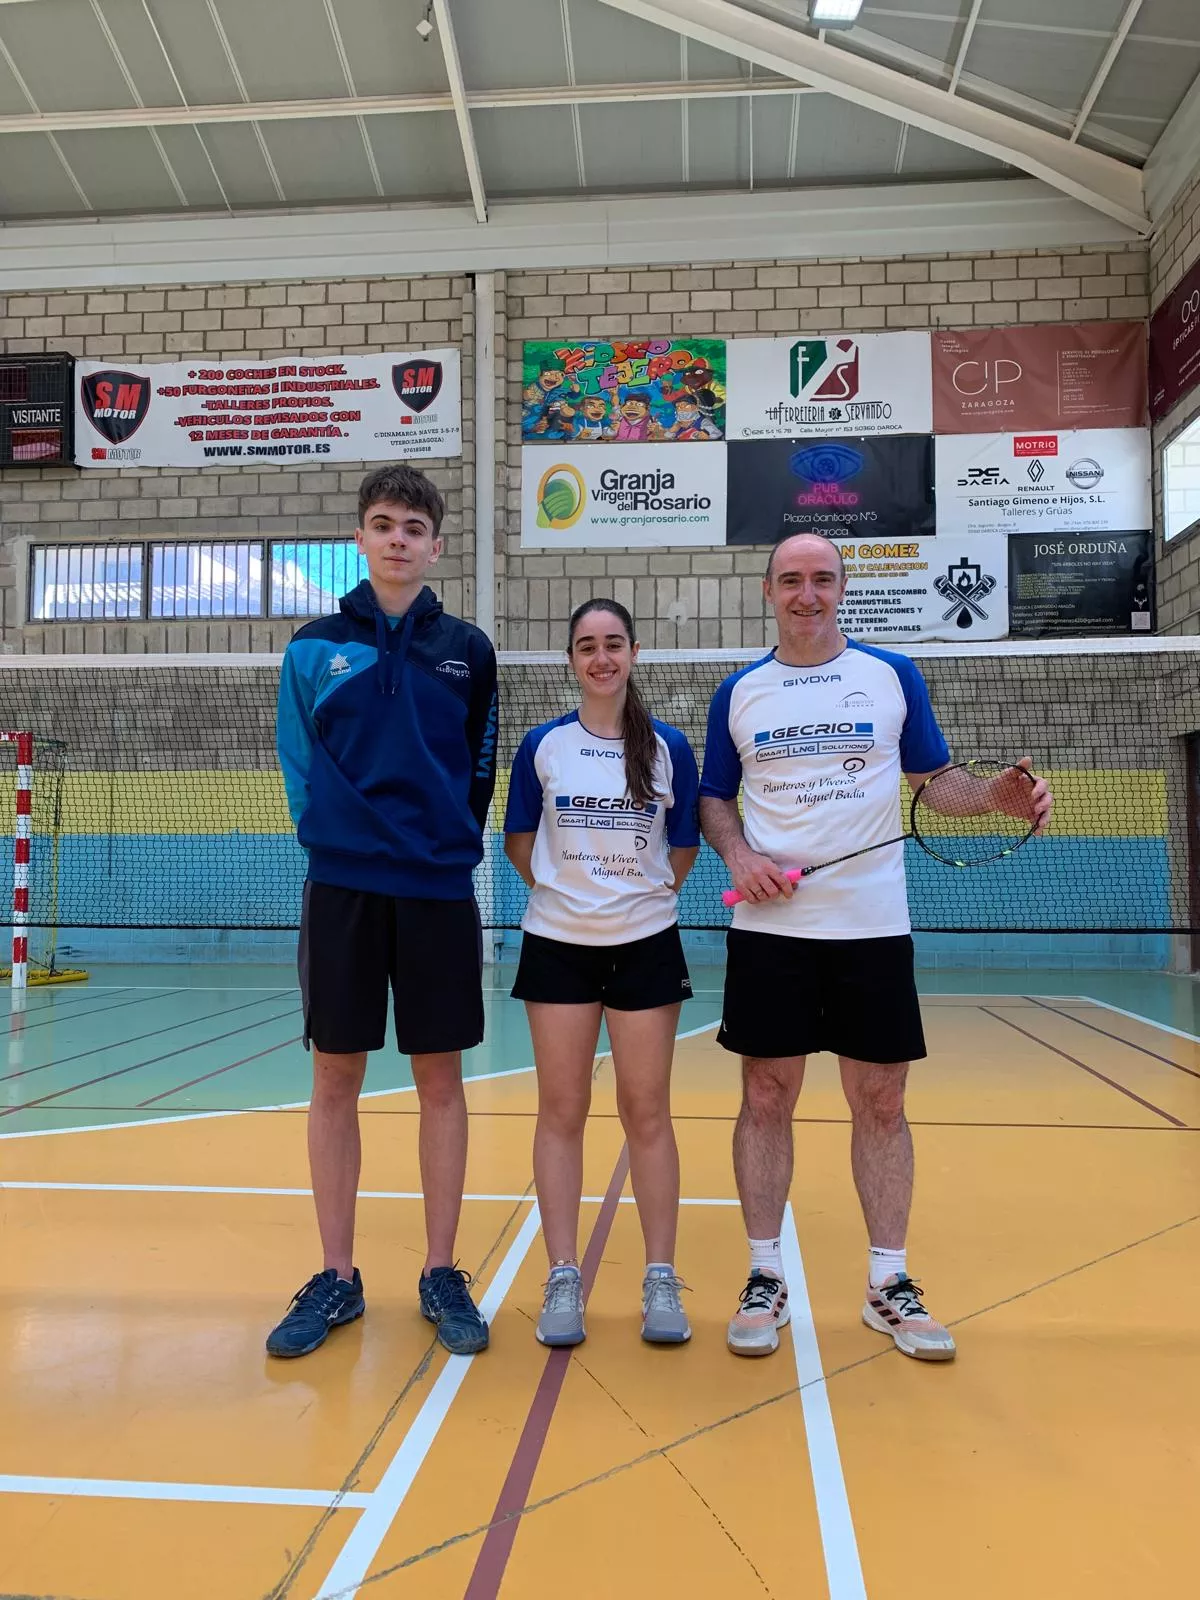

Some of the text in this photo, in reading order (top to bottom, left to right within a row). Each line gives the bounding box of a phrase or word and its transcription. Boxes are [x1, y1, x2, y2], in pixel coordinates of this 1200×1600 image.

[199, 369, 224, 380] 200
[226, 368, 277, 380] COCHES
[278, 366, 297, 377] EN
[299, 364, 348, 377] STOCK.
[953, 359, 1022, 395] CIP
[157, 378, 381, 397] +50 FURGONETAS E INDUSTRIALES.
[401, 386, 433, 395] MOTOR
[201, 397, 335, 411] -TALLERES PROPIOS.
[961, 400, 1015, 409] ZARAGOZA
[12, 408, 61, 424] VISITANTE
[93, 408, 137, 419] MOTOR
[254, 412, 329, 426] REVISADOS
[330, 411, 362, 422] CON
[777, 402, 825, 425] FERRETERIA
[845, 402, 892, 422] SERVANDO
[189, 431, 204, 442] 12
[206, 430, 249, 441] MESES
[251, 429, 270, 441] DE
[271, 425, 342, 440] GARANTÍA
[419, 428, 439, 436] NAVES
[204, 444, 332, 457] WWW.SMMOTOR.ES
[1016, 441, 1056, 450] MOTRIO
[1069, 470, 1102, 478] NISSAN
[600, 468, 675, 496] Granja
[813, 483, 840, 493] PUB
[957, 478, 1011, 487] DACIA
[591, 489, 633, 504] Virgen
[633, 491, 711, 511] Rosario
[798, 494, 858, 505] ORACULO
[968, 498, 1010, 508] Santiago
[1012, 496, 1050, 506] Gimeno
[1060, 495, 1087, 506] Hijos,
[1089, 495, 1106, 504] S.L.
[617, 502, 633, 511] del
[1001, 506, 1073, 517] Talleres y Grúas
[591, 514, 710, 527] www.granjarosario.com
[783, 513, 811, 523] Plaza
[813, 512, 858, 524] Santiago
[812, 527, 849, 536] Daroca
[841, 543, 920, 559] N GOMEZ
[1034, 540, 1128, 558] JOSÉ ORDUÑA
[887, 588, 928, 596] ESCOMBRO
[846, 598, 902, 606] COMBUSTIBLES
[859, 607, 915, 615] EXCAVACIONES
[840, 626, 864, 634] SOLAR
[783, 674, 842, 687] GIVOVA
[772, 722, 853, 739] GECRIO
[580, 748, 626, 759] GIVOV
[759, 743, 869, 759] SMART LNG SOLUTIONS
[763, 778, 856, 794] Planteros y Viveros
[571, 795, 645, 811] GECRIO
[795, 789, 834, 807] Miguel
[590, 819, 611, 827] LNG
[602, 854, 609, 865] y
[591, 867, 625, 880] Miguel
